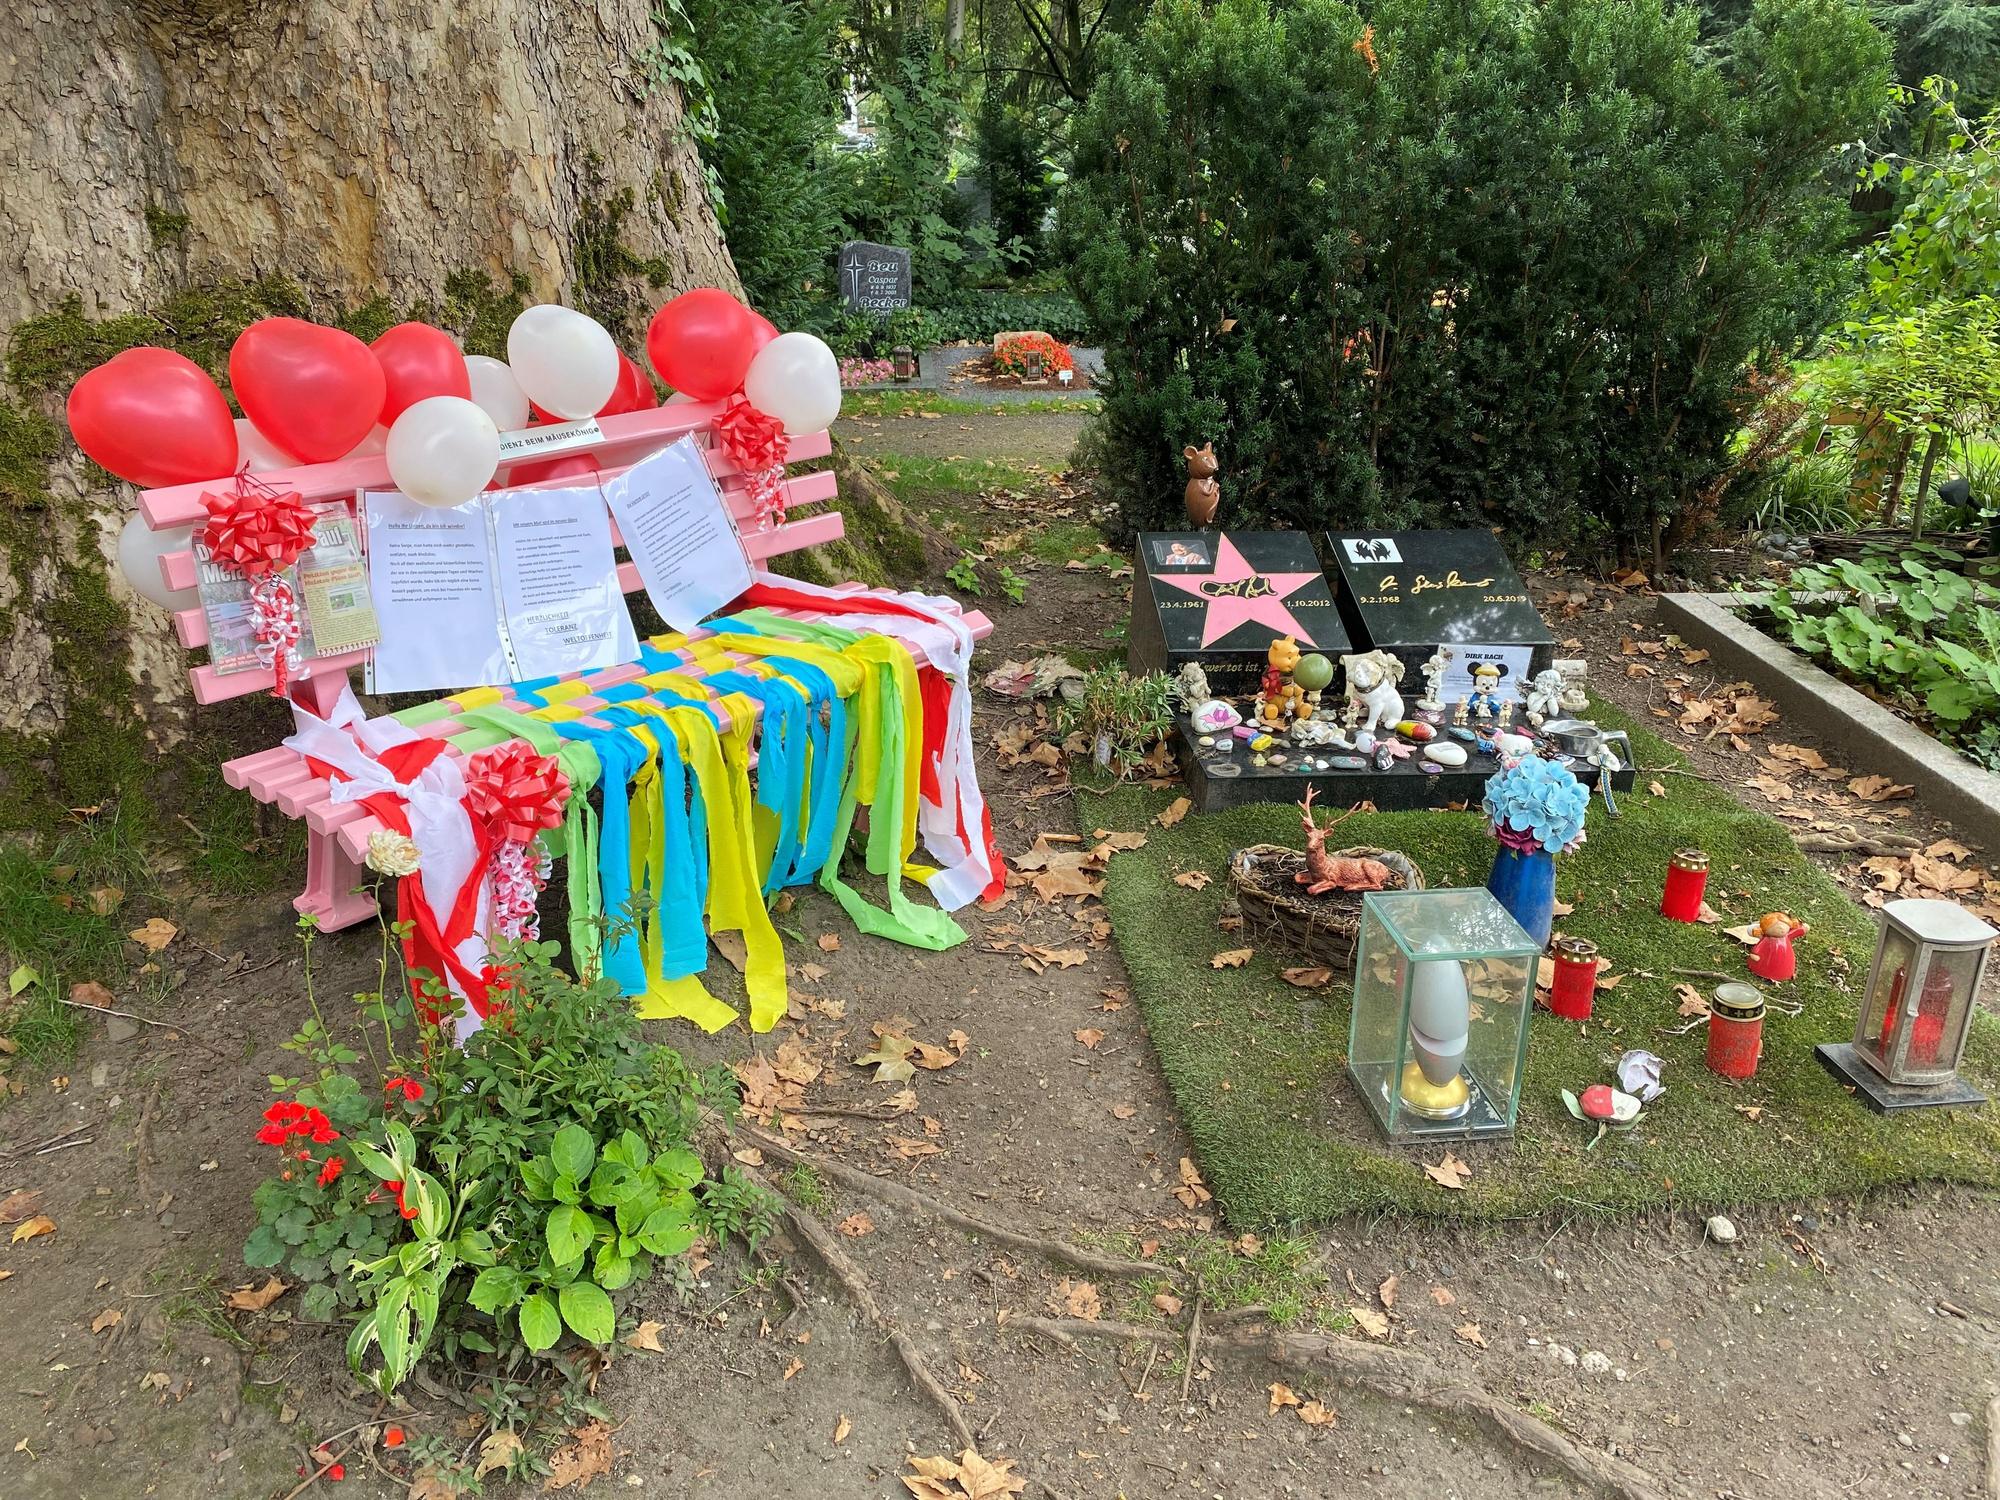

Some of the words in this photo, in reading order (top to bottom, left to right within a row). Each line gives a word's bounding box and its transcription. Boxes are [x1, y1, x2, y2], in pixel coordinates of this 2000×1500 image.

[868, 275, 898, 285] Caspar
[859, 296, 907, 308] Becker
[525, 436, 544, 446] BEIM
[545, 427, 594, 442] MÄUSEKÖNIG
[1286, 599, 1331, 608] 1.10.2012
[1360, 596, 1400, 604] 9.2.1968
[1482, 594, 1527, 603] 20.6.2019
[545, 623, 578, 635] TOLERANZ
[1205, 663, 1225, 673] wer
[1226, 662, 1243, 672] tot
